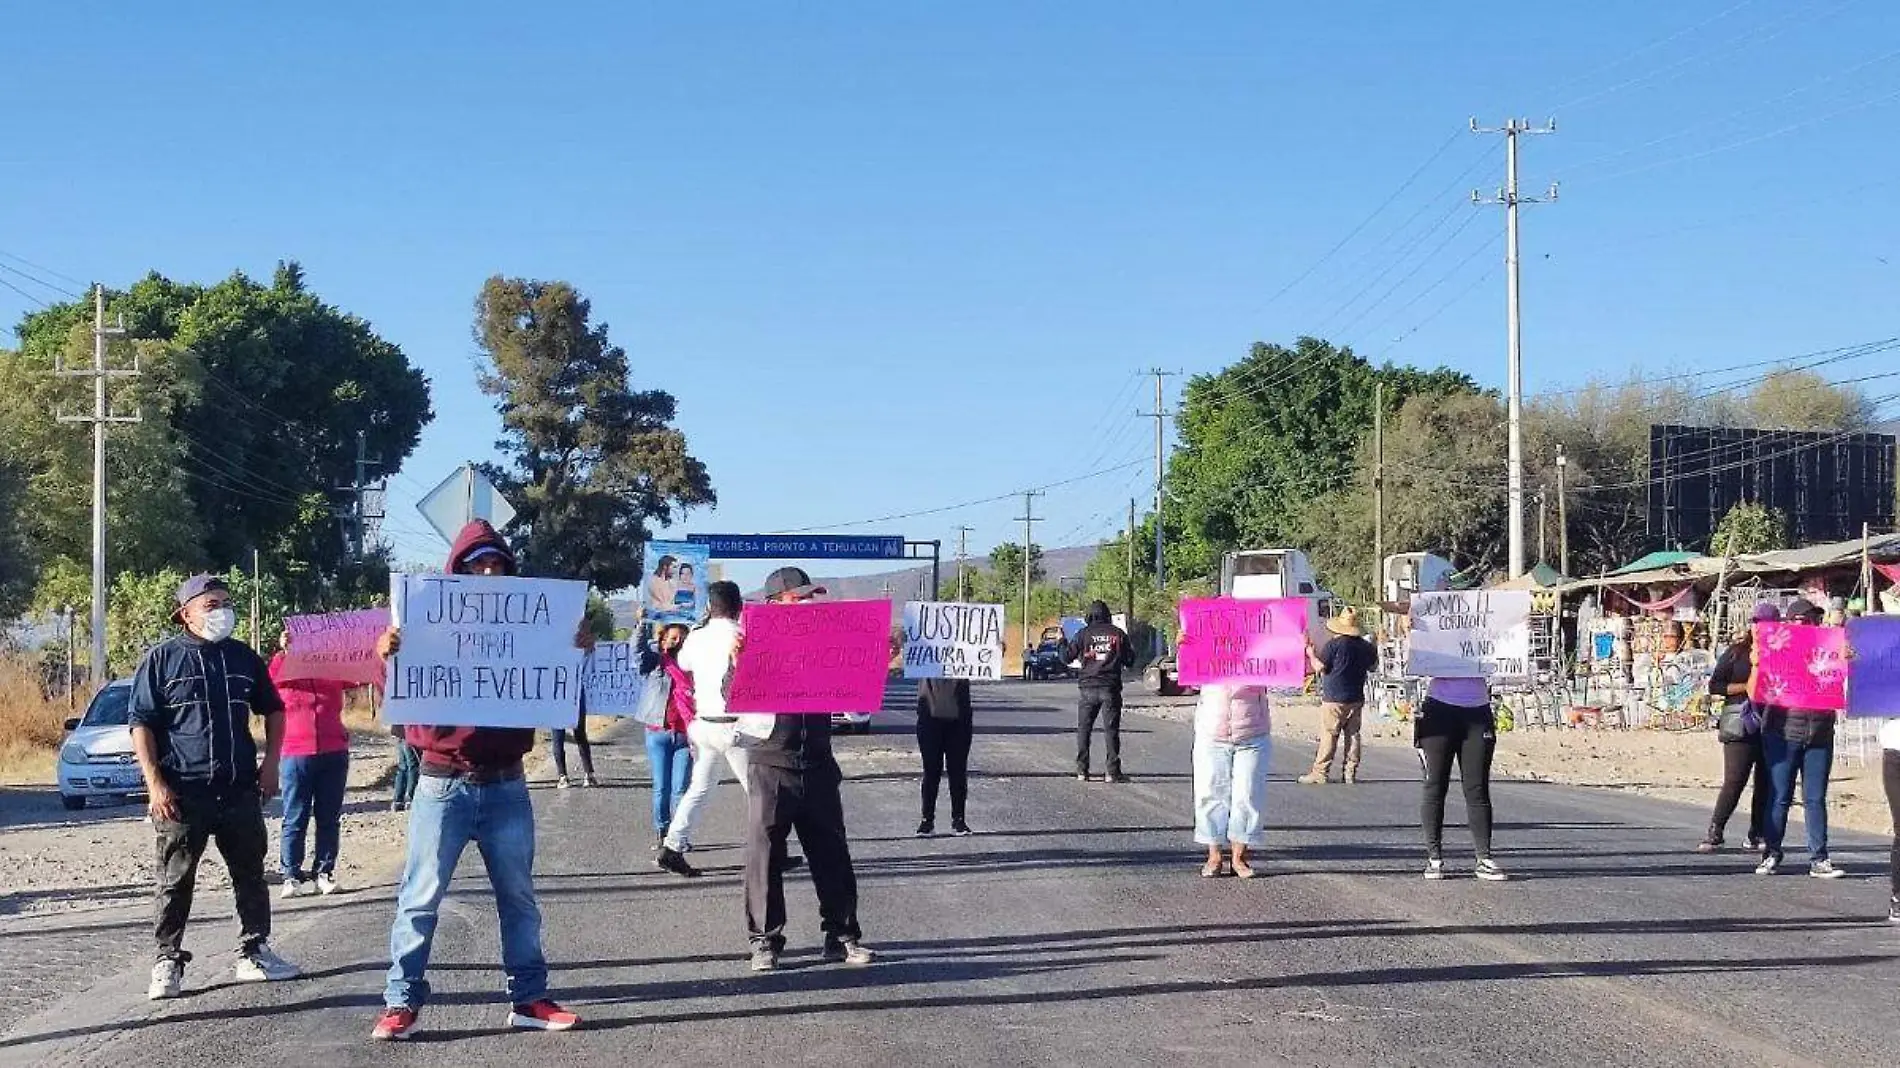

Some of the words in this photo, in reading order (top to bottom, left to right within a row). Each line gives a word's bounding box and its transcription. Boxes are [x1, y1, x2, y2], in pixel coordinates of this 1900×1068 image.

[709, 540, 759, 551] REGRESA
[764, 541, 805, 551] PRONTO
[810, 542, 818, 551] A
[908, 604, 1001, 645] JUSTICIA
[450, 630, 514, 659] PARA
[1460, 640, 1475, 658] YA
[1478, 640, 1495, 657] NO
[390, 656, 462, 700] LAURA
